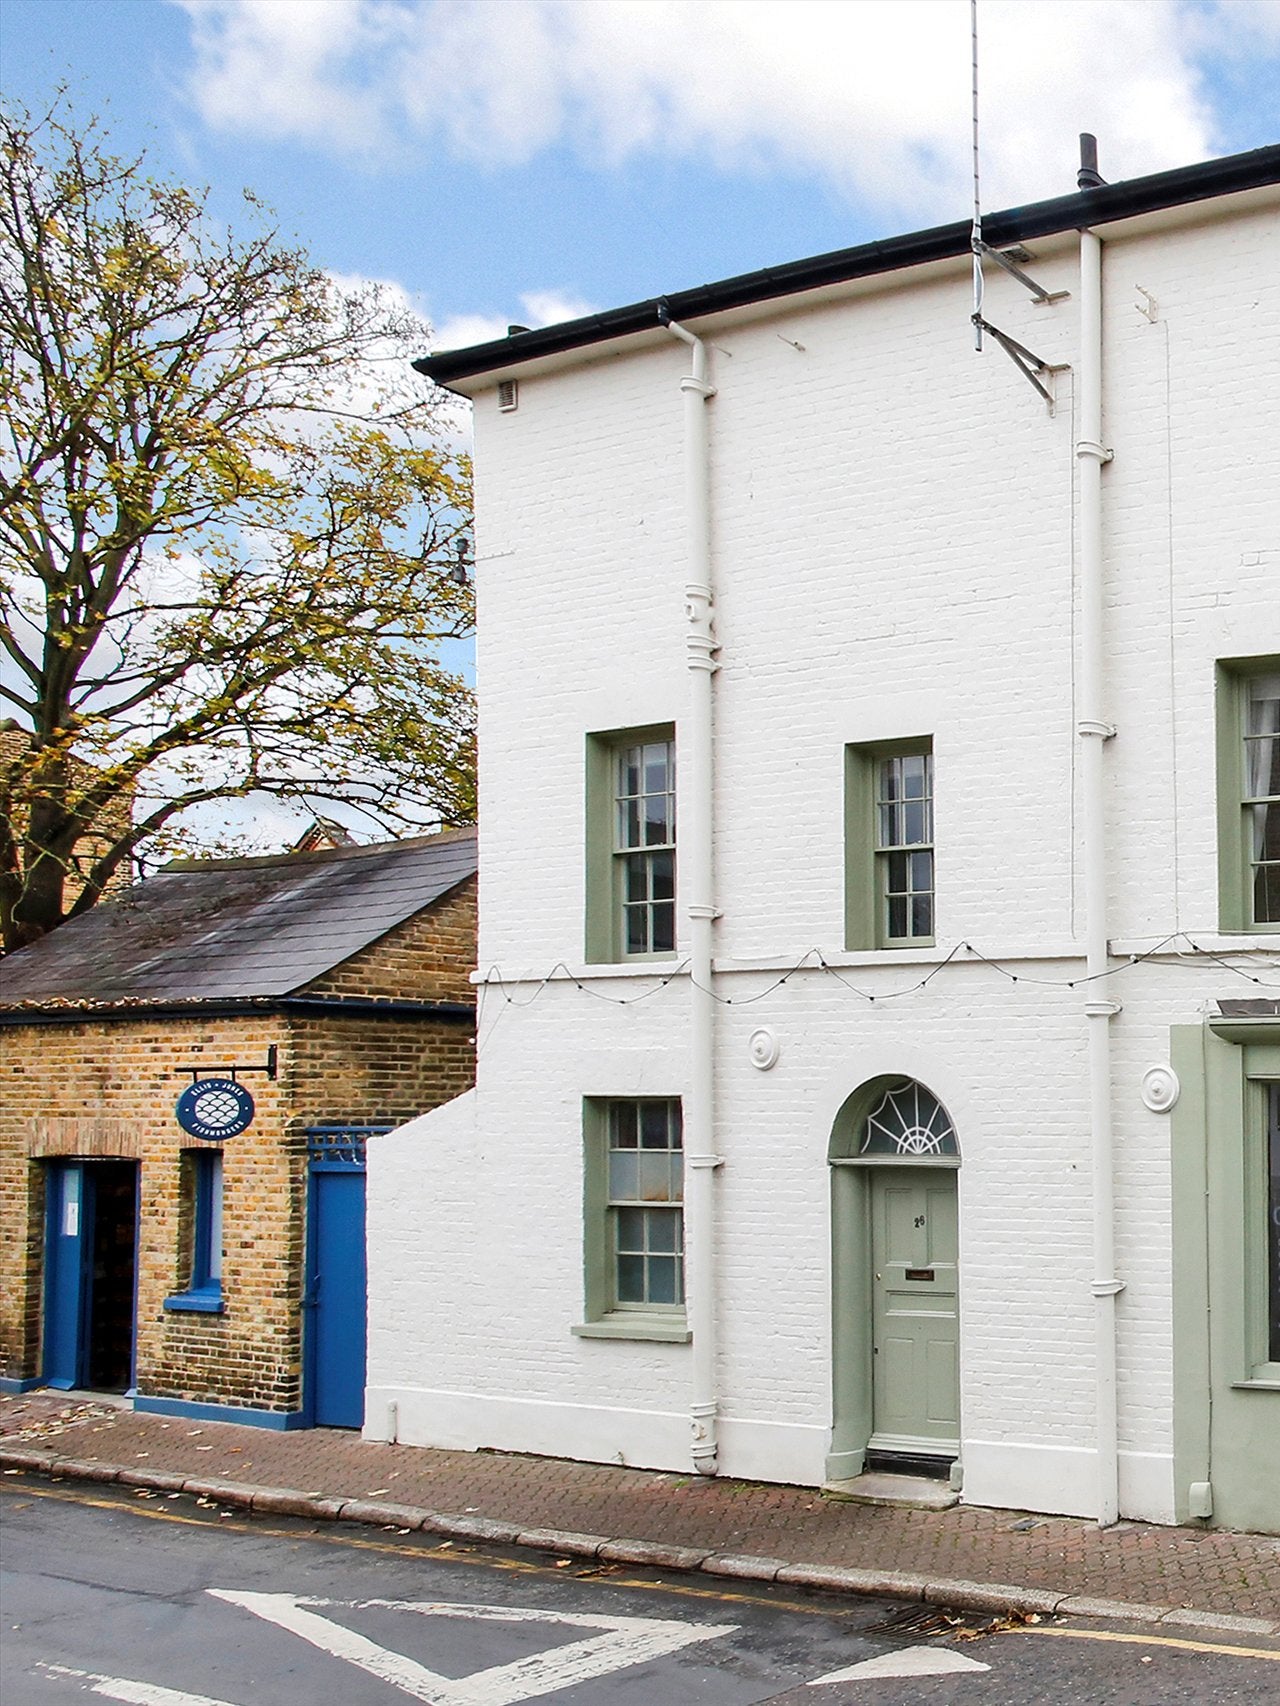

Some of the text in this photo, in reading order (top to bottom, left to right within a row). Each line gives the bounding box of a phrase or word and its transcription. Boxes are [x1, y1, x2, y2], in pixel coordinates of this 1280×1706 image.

[191, 1082, 244, 1097] ELLIS JONES
[191, 1120, 245, 1136] FISHMONGERS
